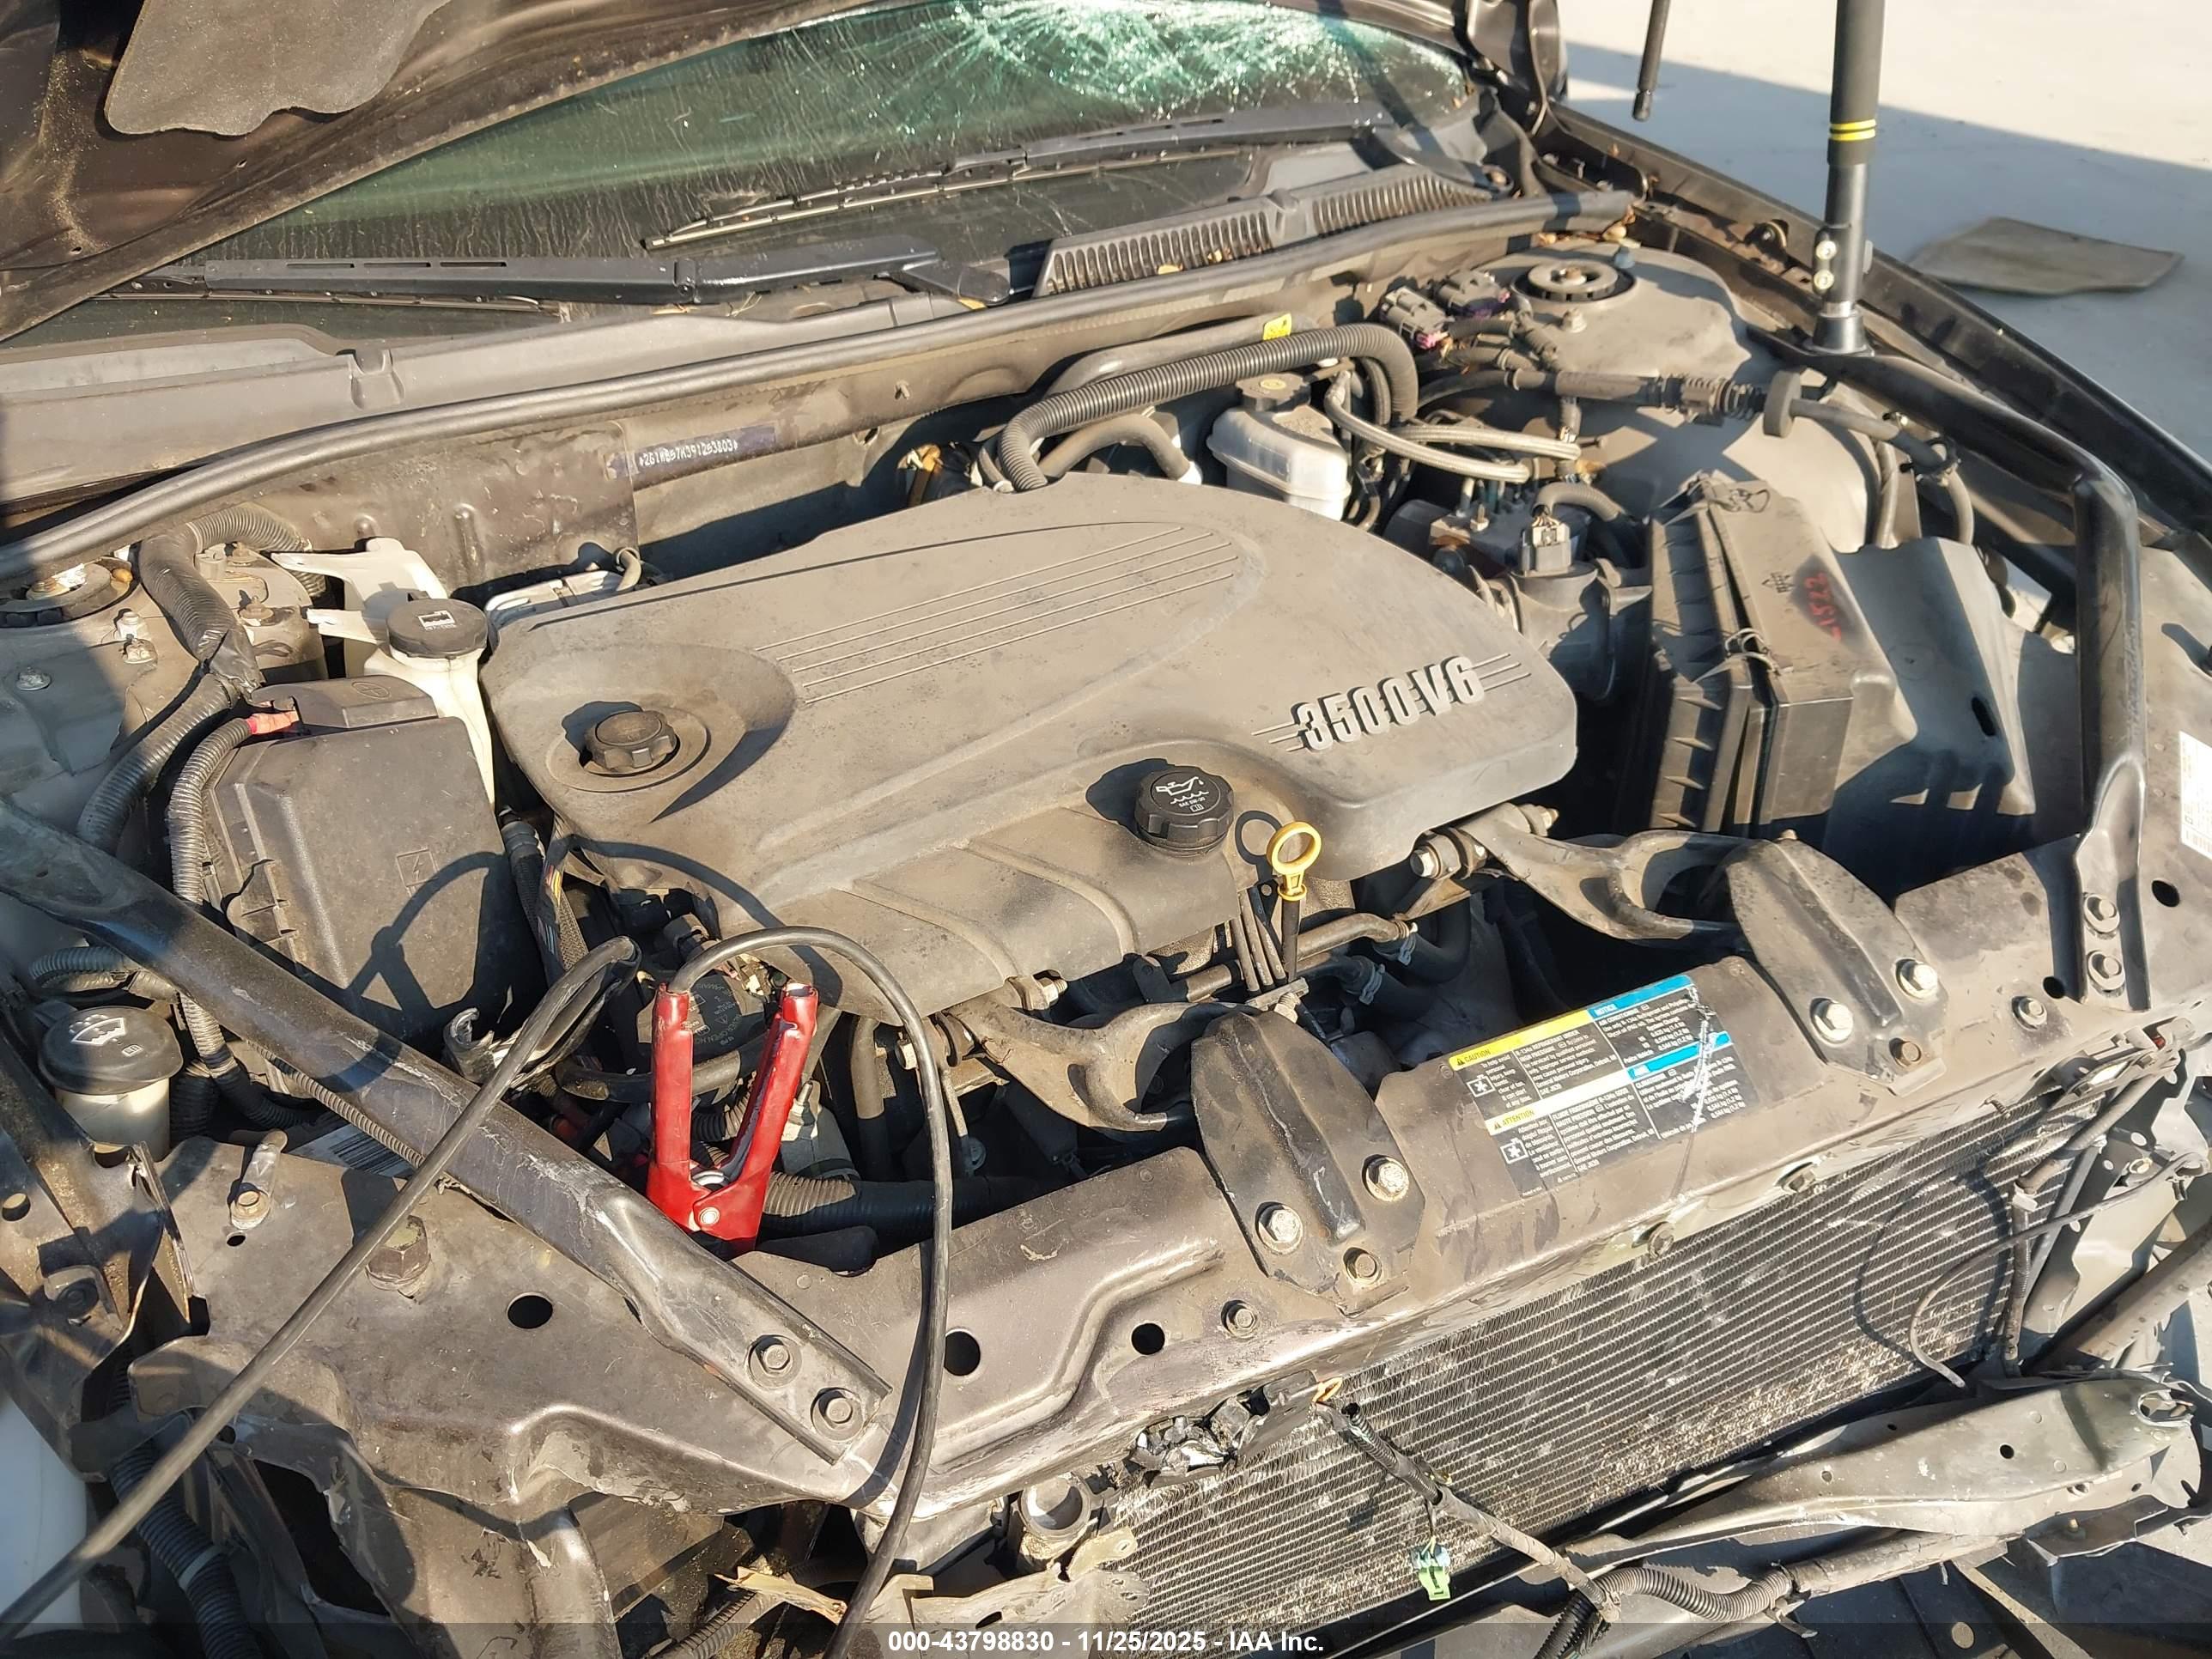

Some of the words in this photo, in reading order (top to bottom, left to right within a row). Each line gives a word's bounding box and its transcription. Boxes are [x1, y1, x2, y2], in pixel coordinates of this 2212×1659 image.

[1593, 1003, 1617, 1016] NOTICE
[1463, 1048, 1491, 1062] CAUTION
[1486, 1058, 1498, 1066] help
[1497, 1054, 1510, 1062] avoid
[1485, 1063, 1506, 1075] personal
[1500, 1108, 1534, 1126] ATTENTION
